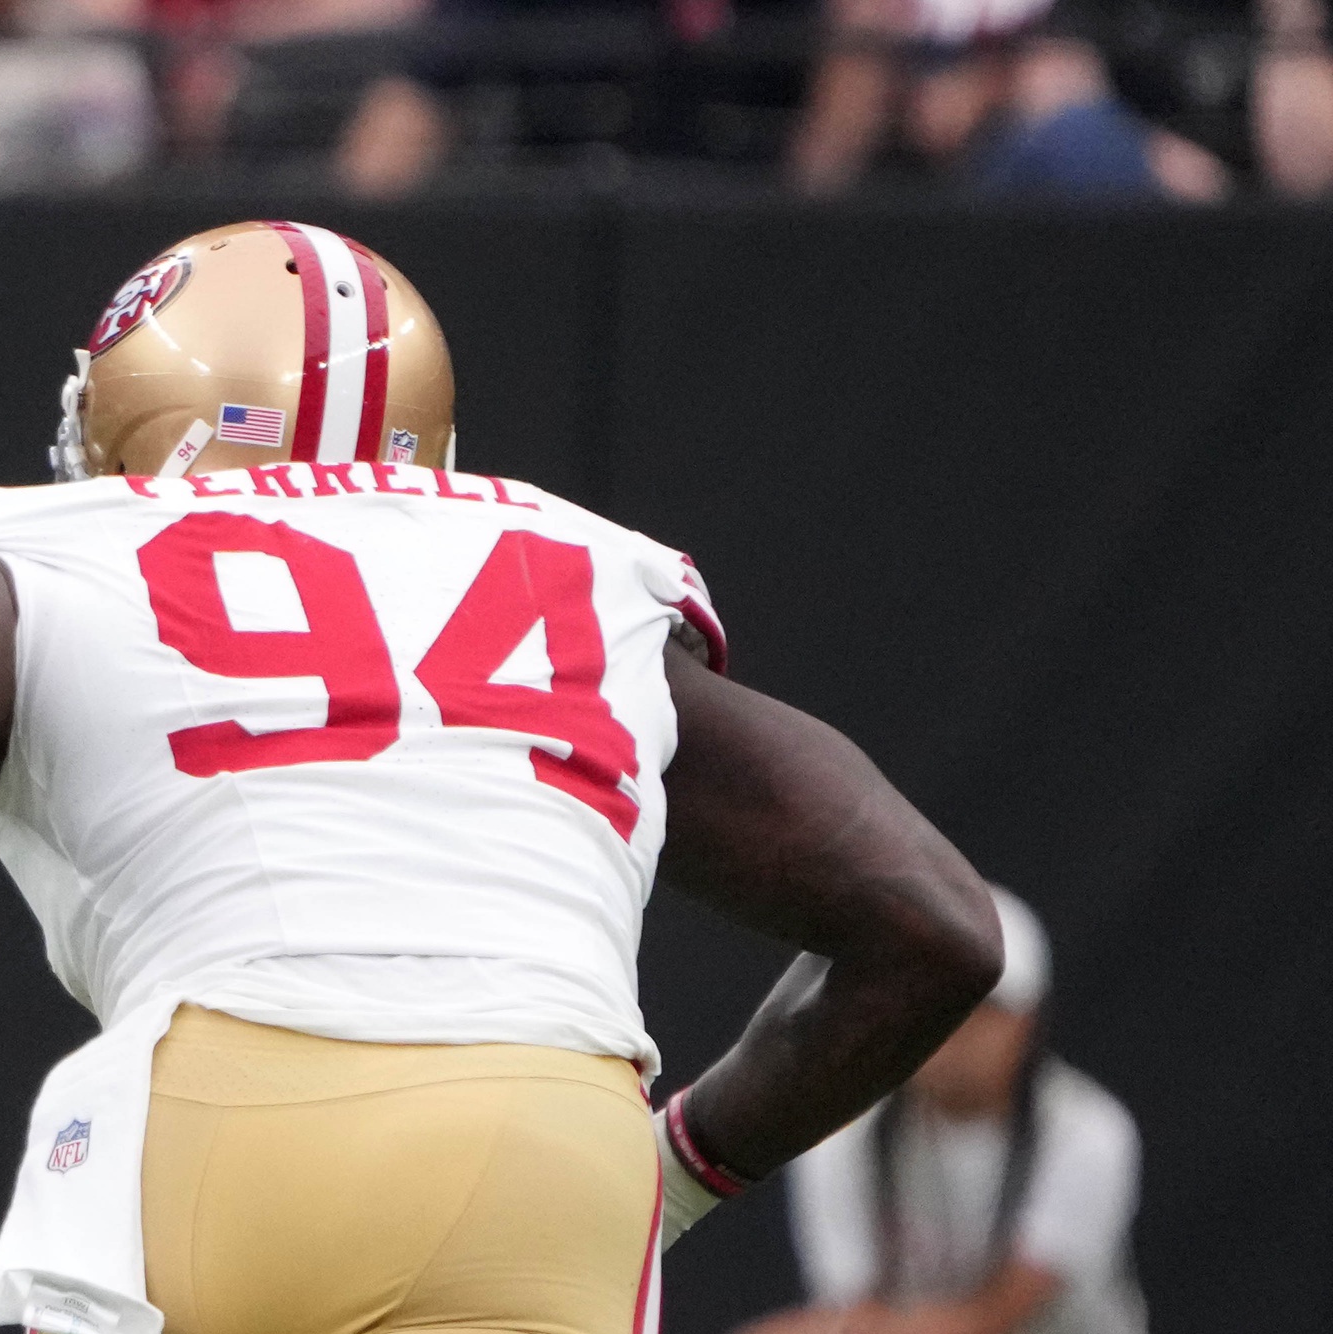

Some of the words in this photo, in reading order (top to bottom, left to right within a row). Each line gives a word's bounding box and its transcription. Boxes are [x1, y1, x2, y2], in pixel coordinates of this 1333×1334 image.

[177, 441, 198, 462] 94
[136, 510, 640, 844] 94
[51, 1141, 85, 1168] NFL
